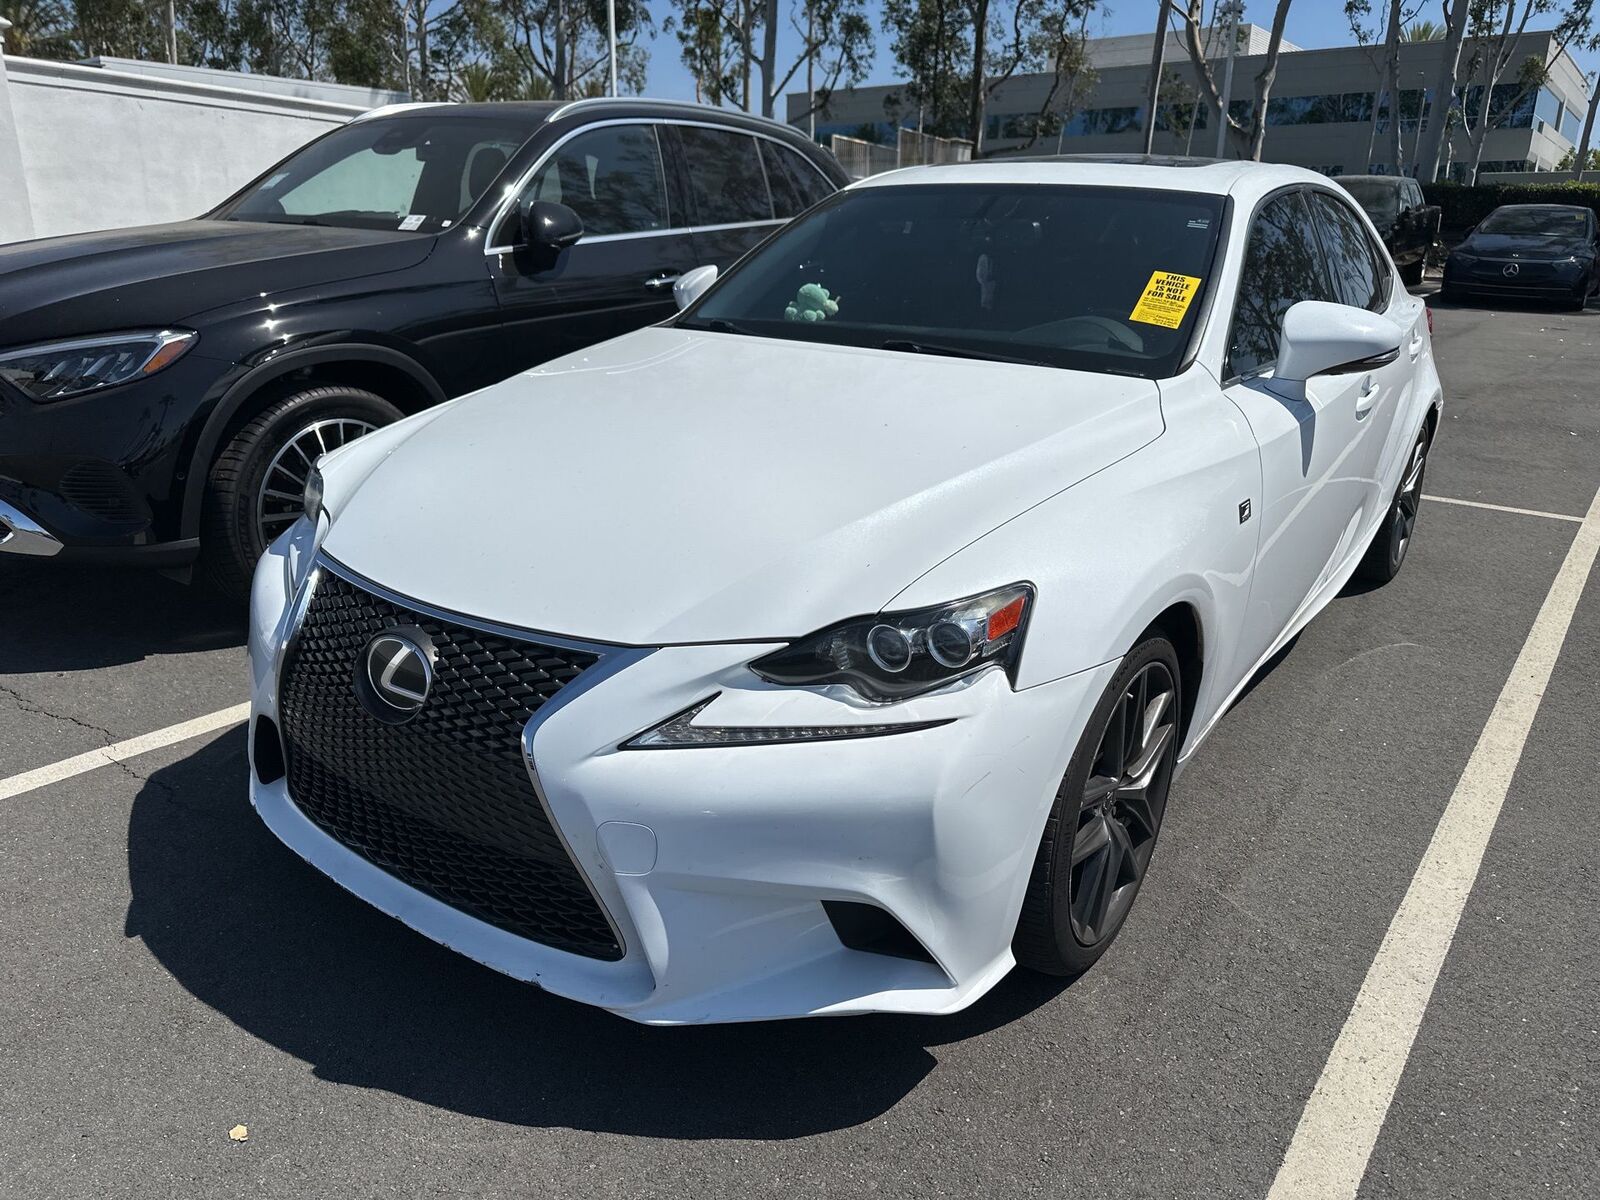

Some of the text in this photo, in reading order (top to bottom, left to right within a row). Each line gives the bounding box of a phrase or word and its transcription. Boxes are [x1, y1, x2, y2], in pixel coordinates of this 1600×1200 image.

[1166, 275, 1186, 283] THIS
[1156, 279, 1191, 290] VEHICLE
[1166, 287, 1184, 295] NOT
[1147, 290, 1187, 302] FOR SALE
